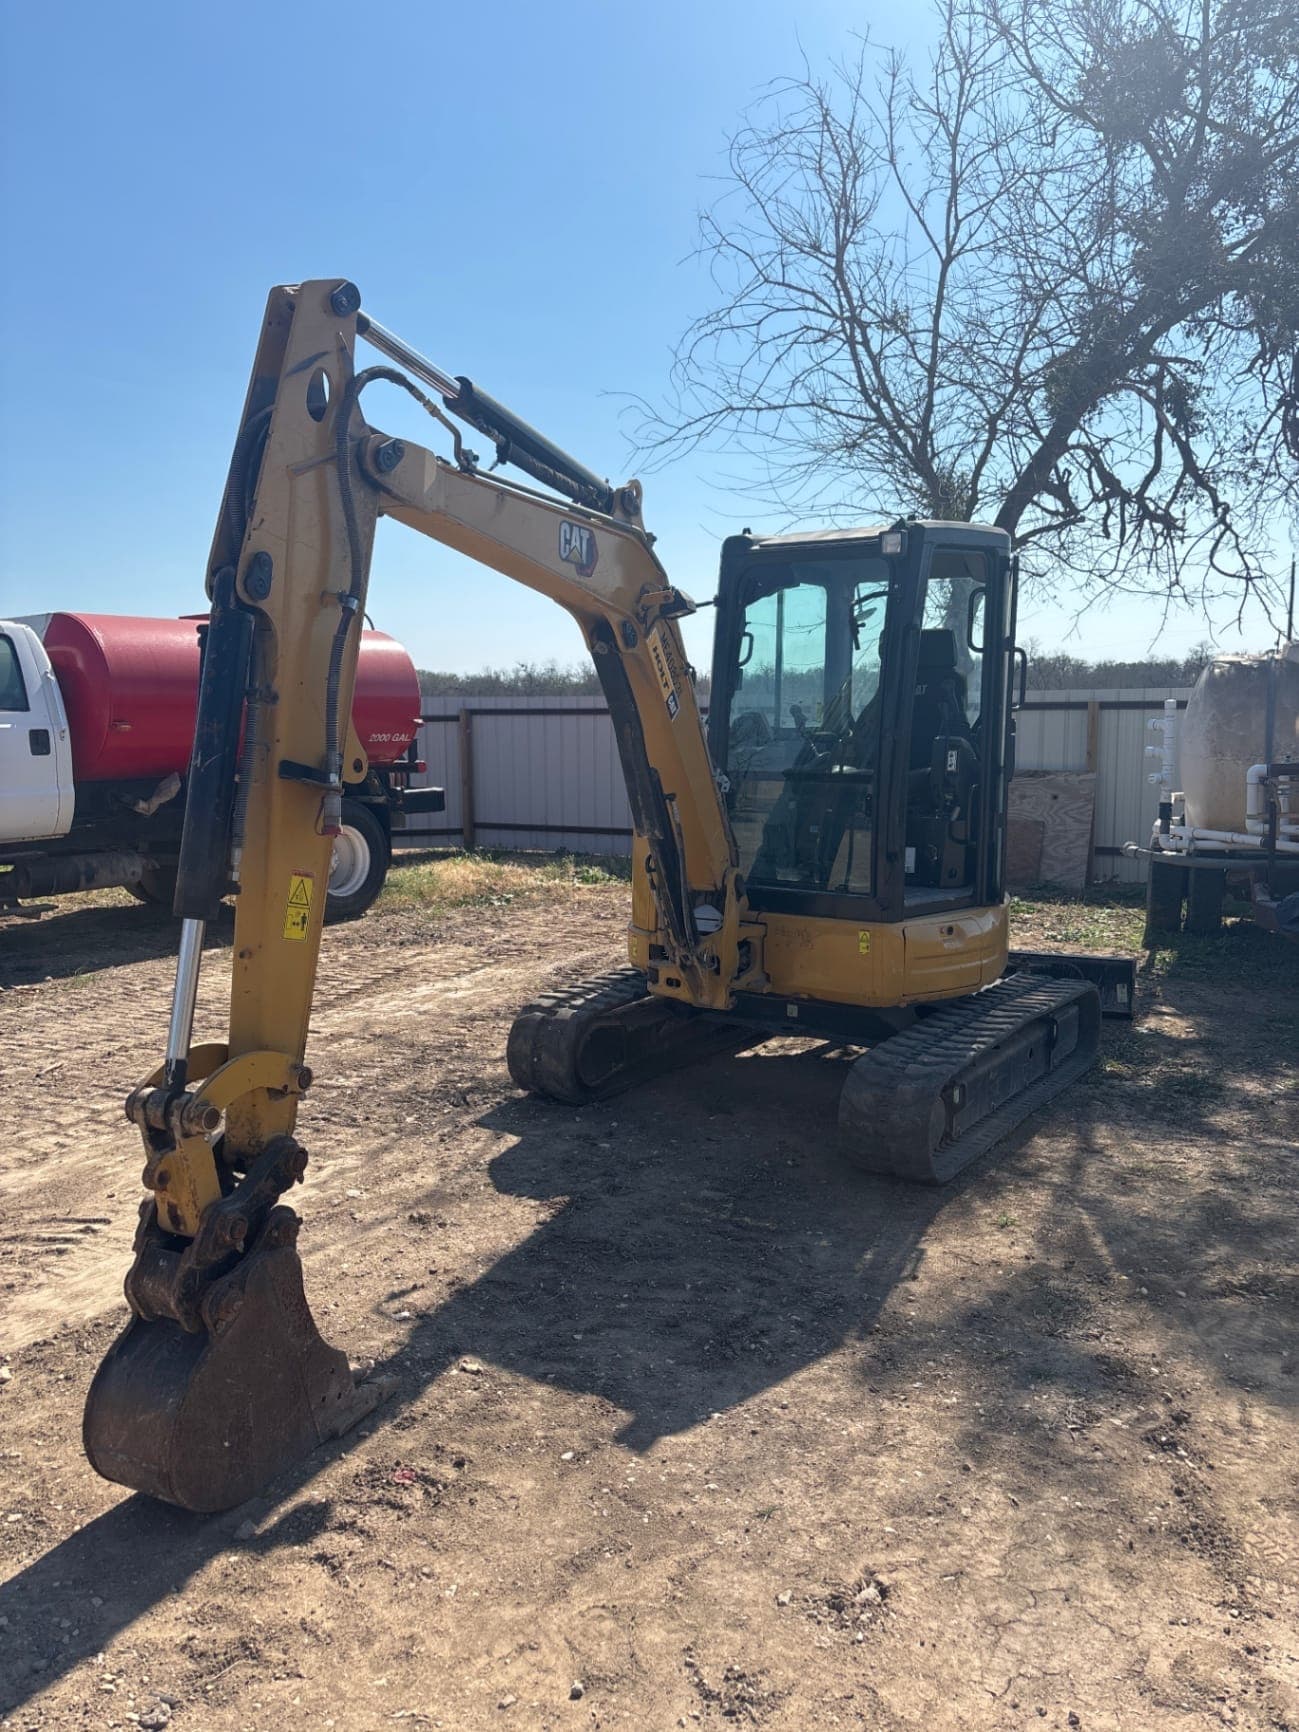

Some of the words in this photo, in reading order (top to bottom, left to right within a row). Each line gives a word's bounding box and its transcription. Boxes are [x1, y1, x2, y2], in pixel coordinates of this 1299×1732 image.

[560, 522, 590, 565] CAT
[652, 646, 671, 689] HOLT
[667, 695, 678, 715] CAT
[368, 733, 391, 742] 2000
